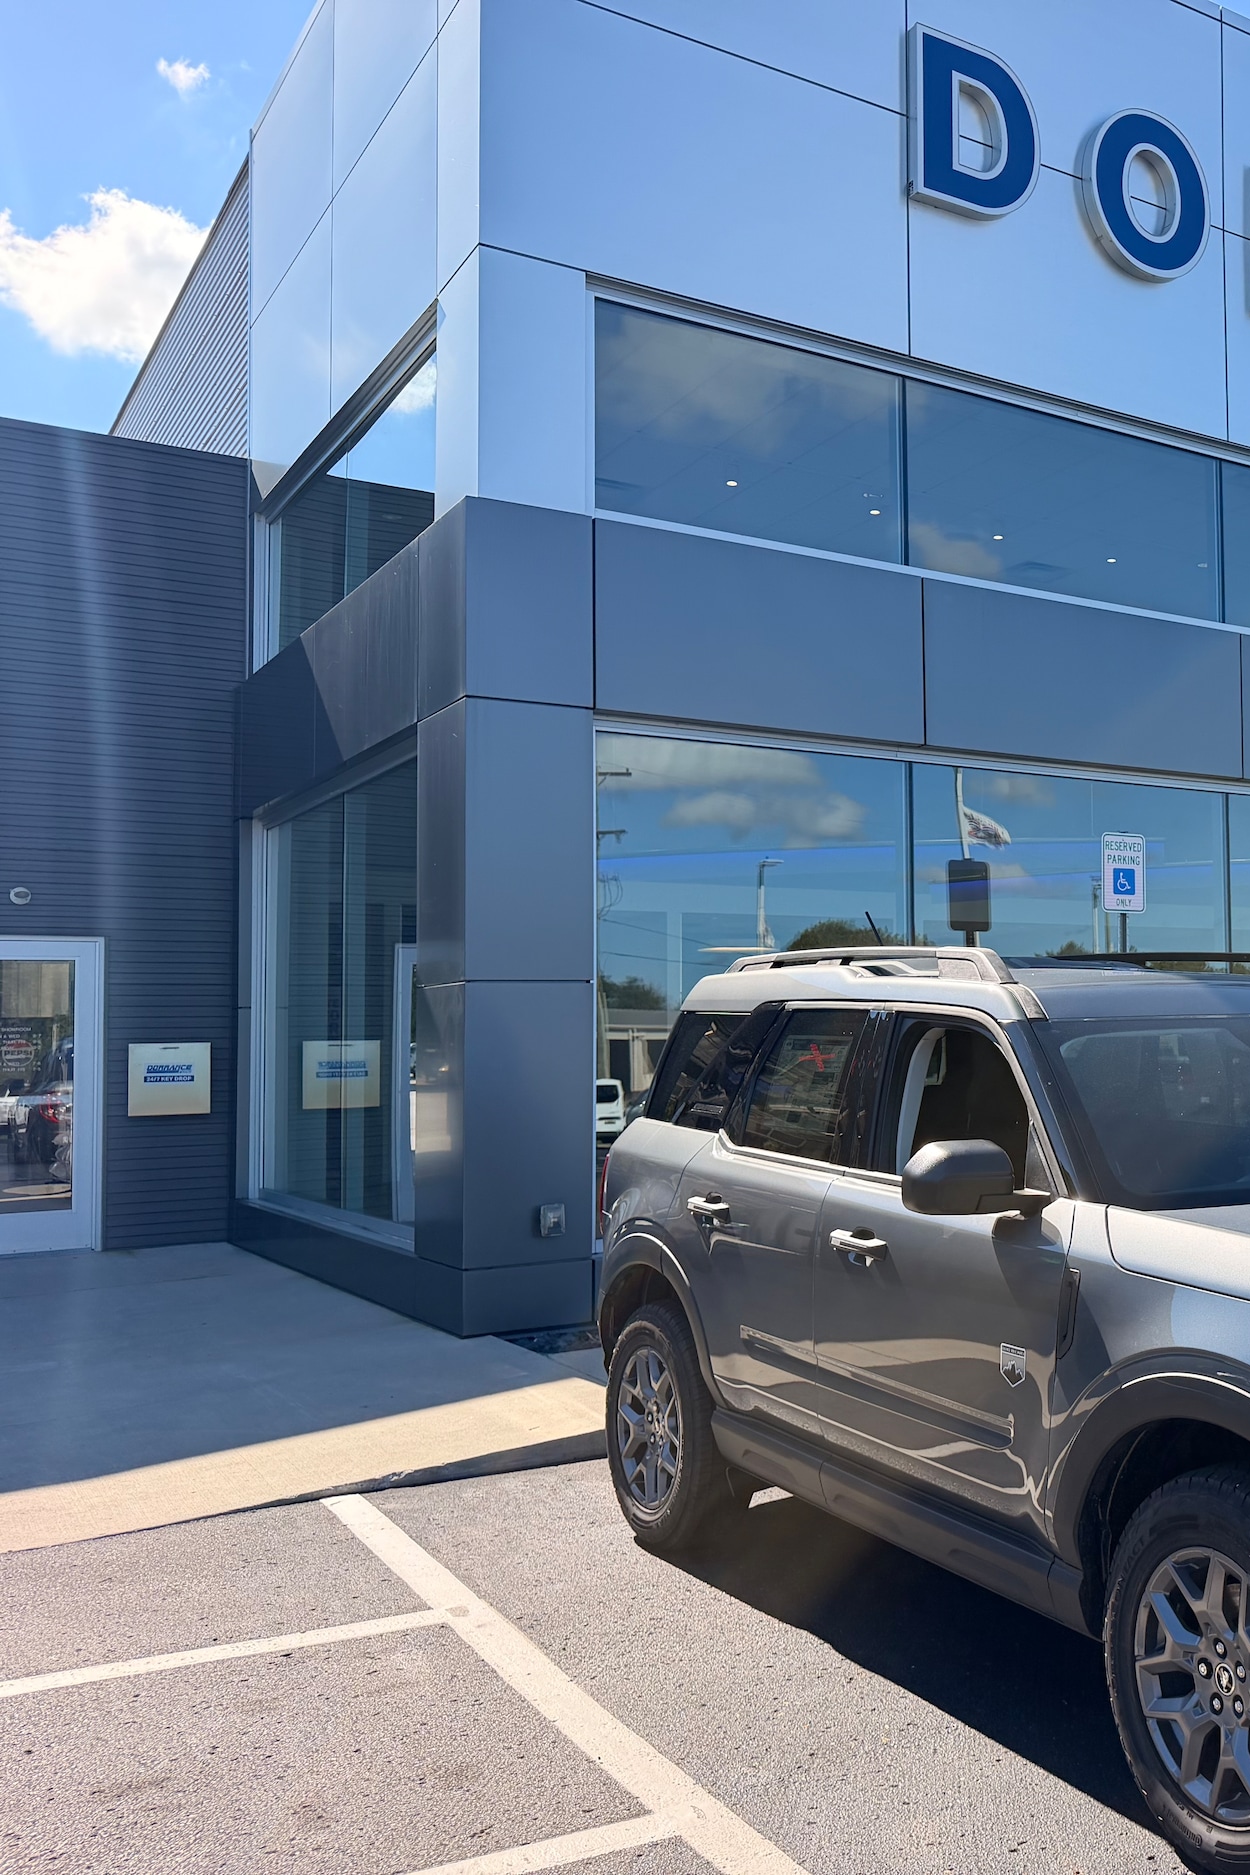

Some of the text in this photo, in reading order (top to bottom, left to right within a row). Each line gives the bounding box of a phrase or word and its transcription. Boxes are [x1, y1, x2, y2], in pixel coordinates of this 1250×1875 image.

[1105, 840, 1142, 852] RESERVED
[1107, 854, 1140, 866] PARKING
[1116, 898, 1132, 908] ONLY
